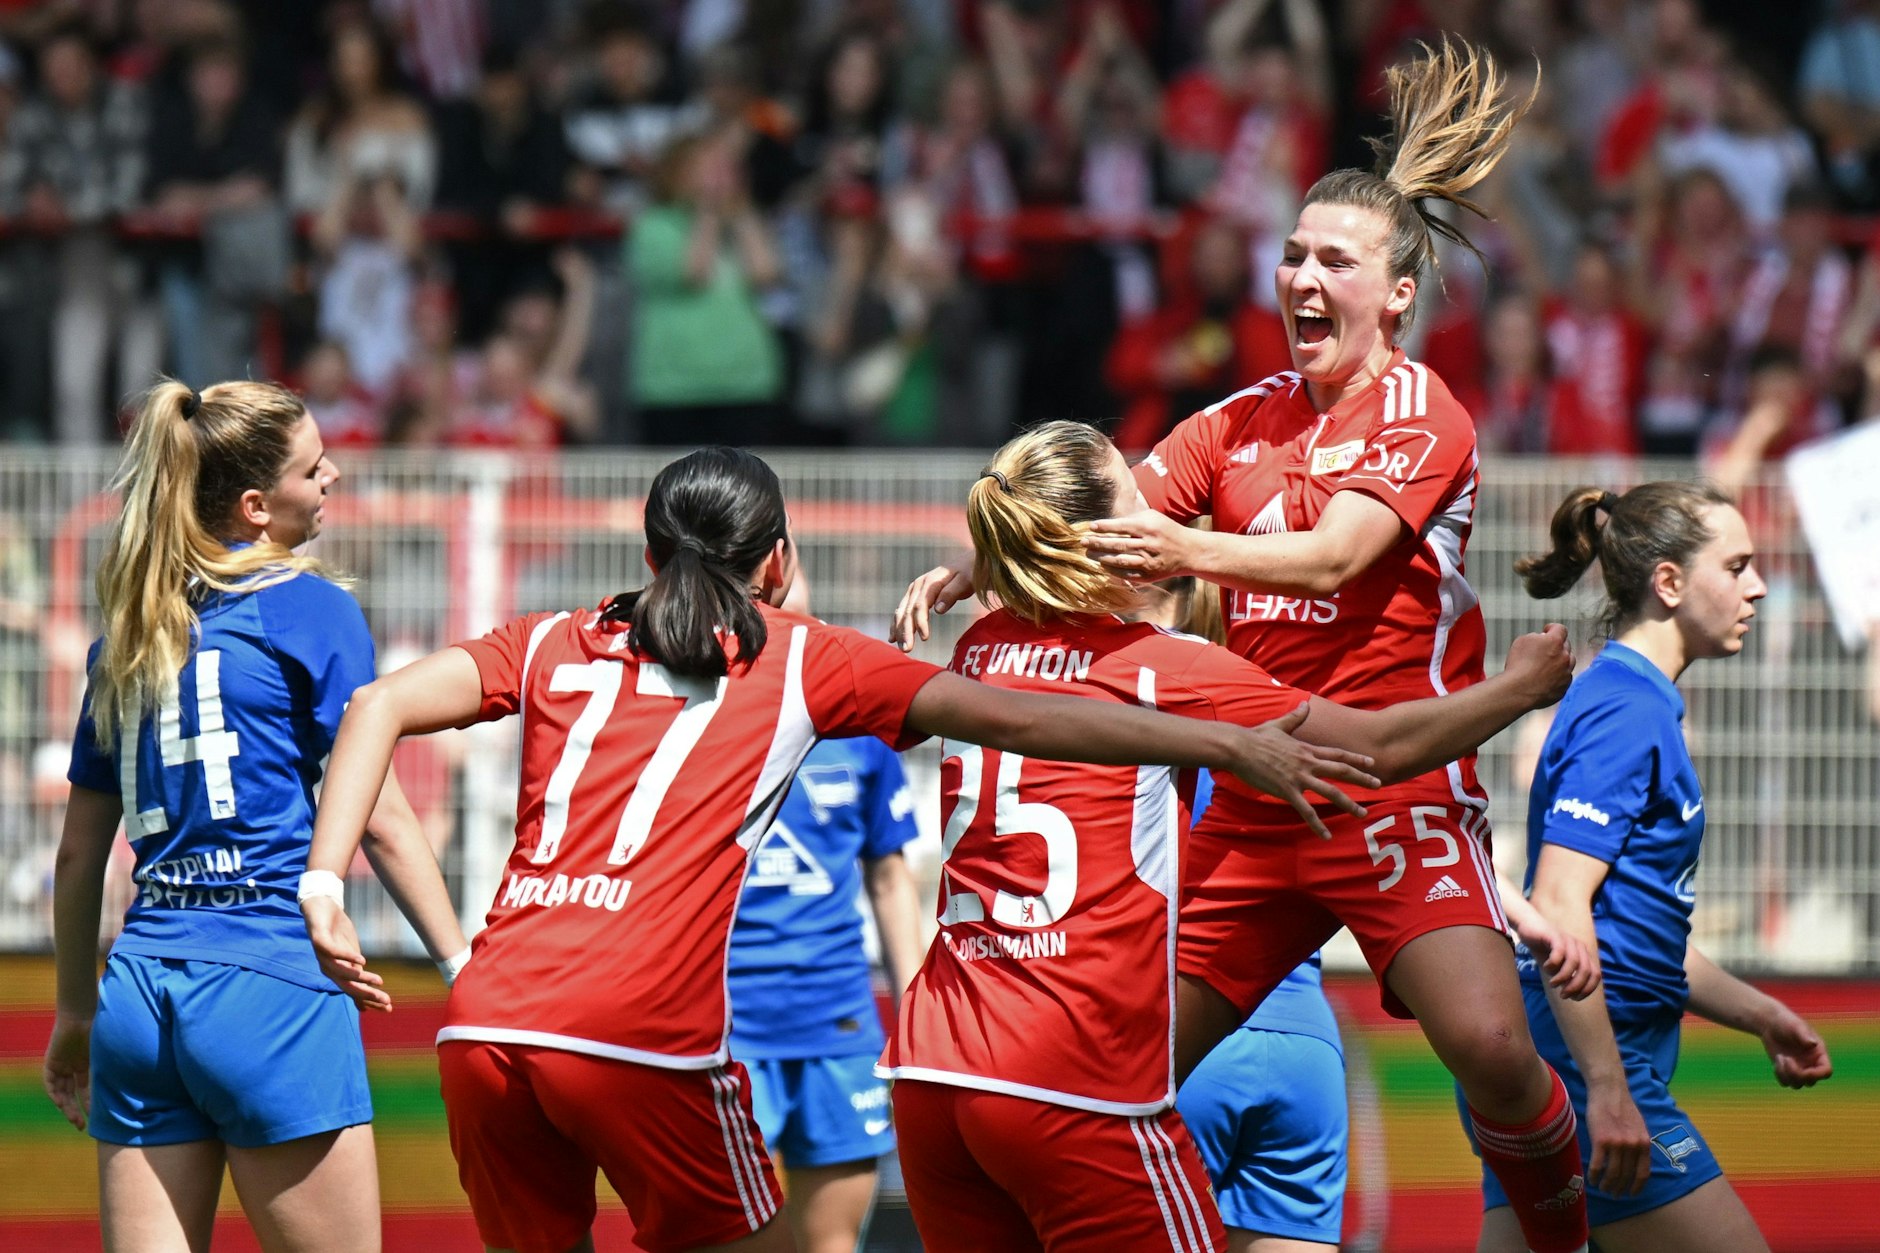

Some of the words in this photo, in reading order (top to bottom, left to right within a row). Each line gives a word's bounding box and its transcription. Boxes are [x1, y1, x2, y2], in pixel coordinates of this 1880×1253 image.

[986, 643, 1094, 683] UNION
[530, 659, 729, 866] 77
[937, 736, 1078, 928] 25
[1363, 806, 1460, 893] 55
[1424, 888, 1469, 903] adidas
